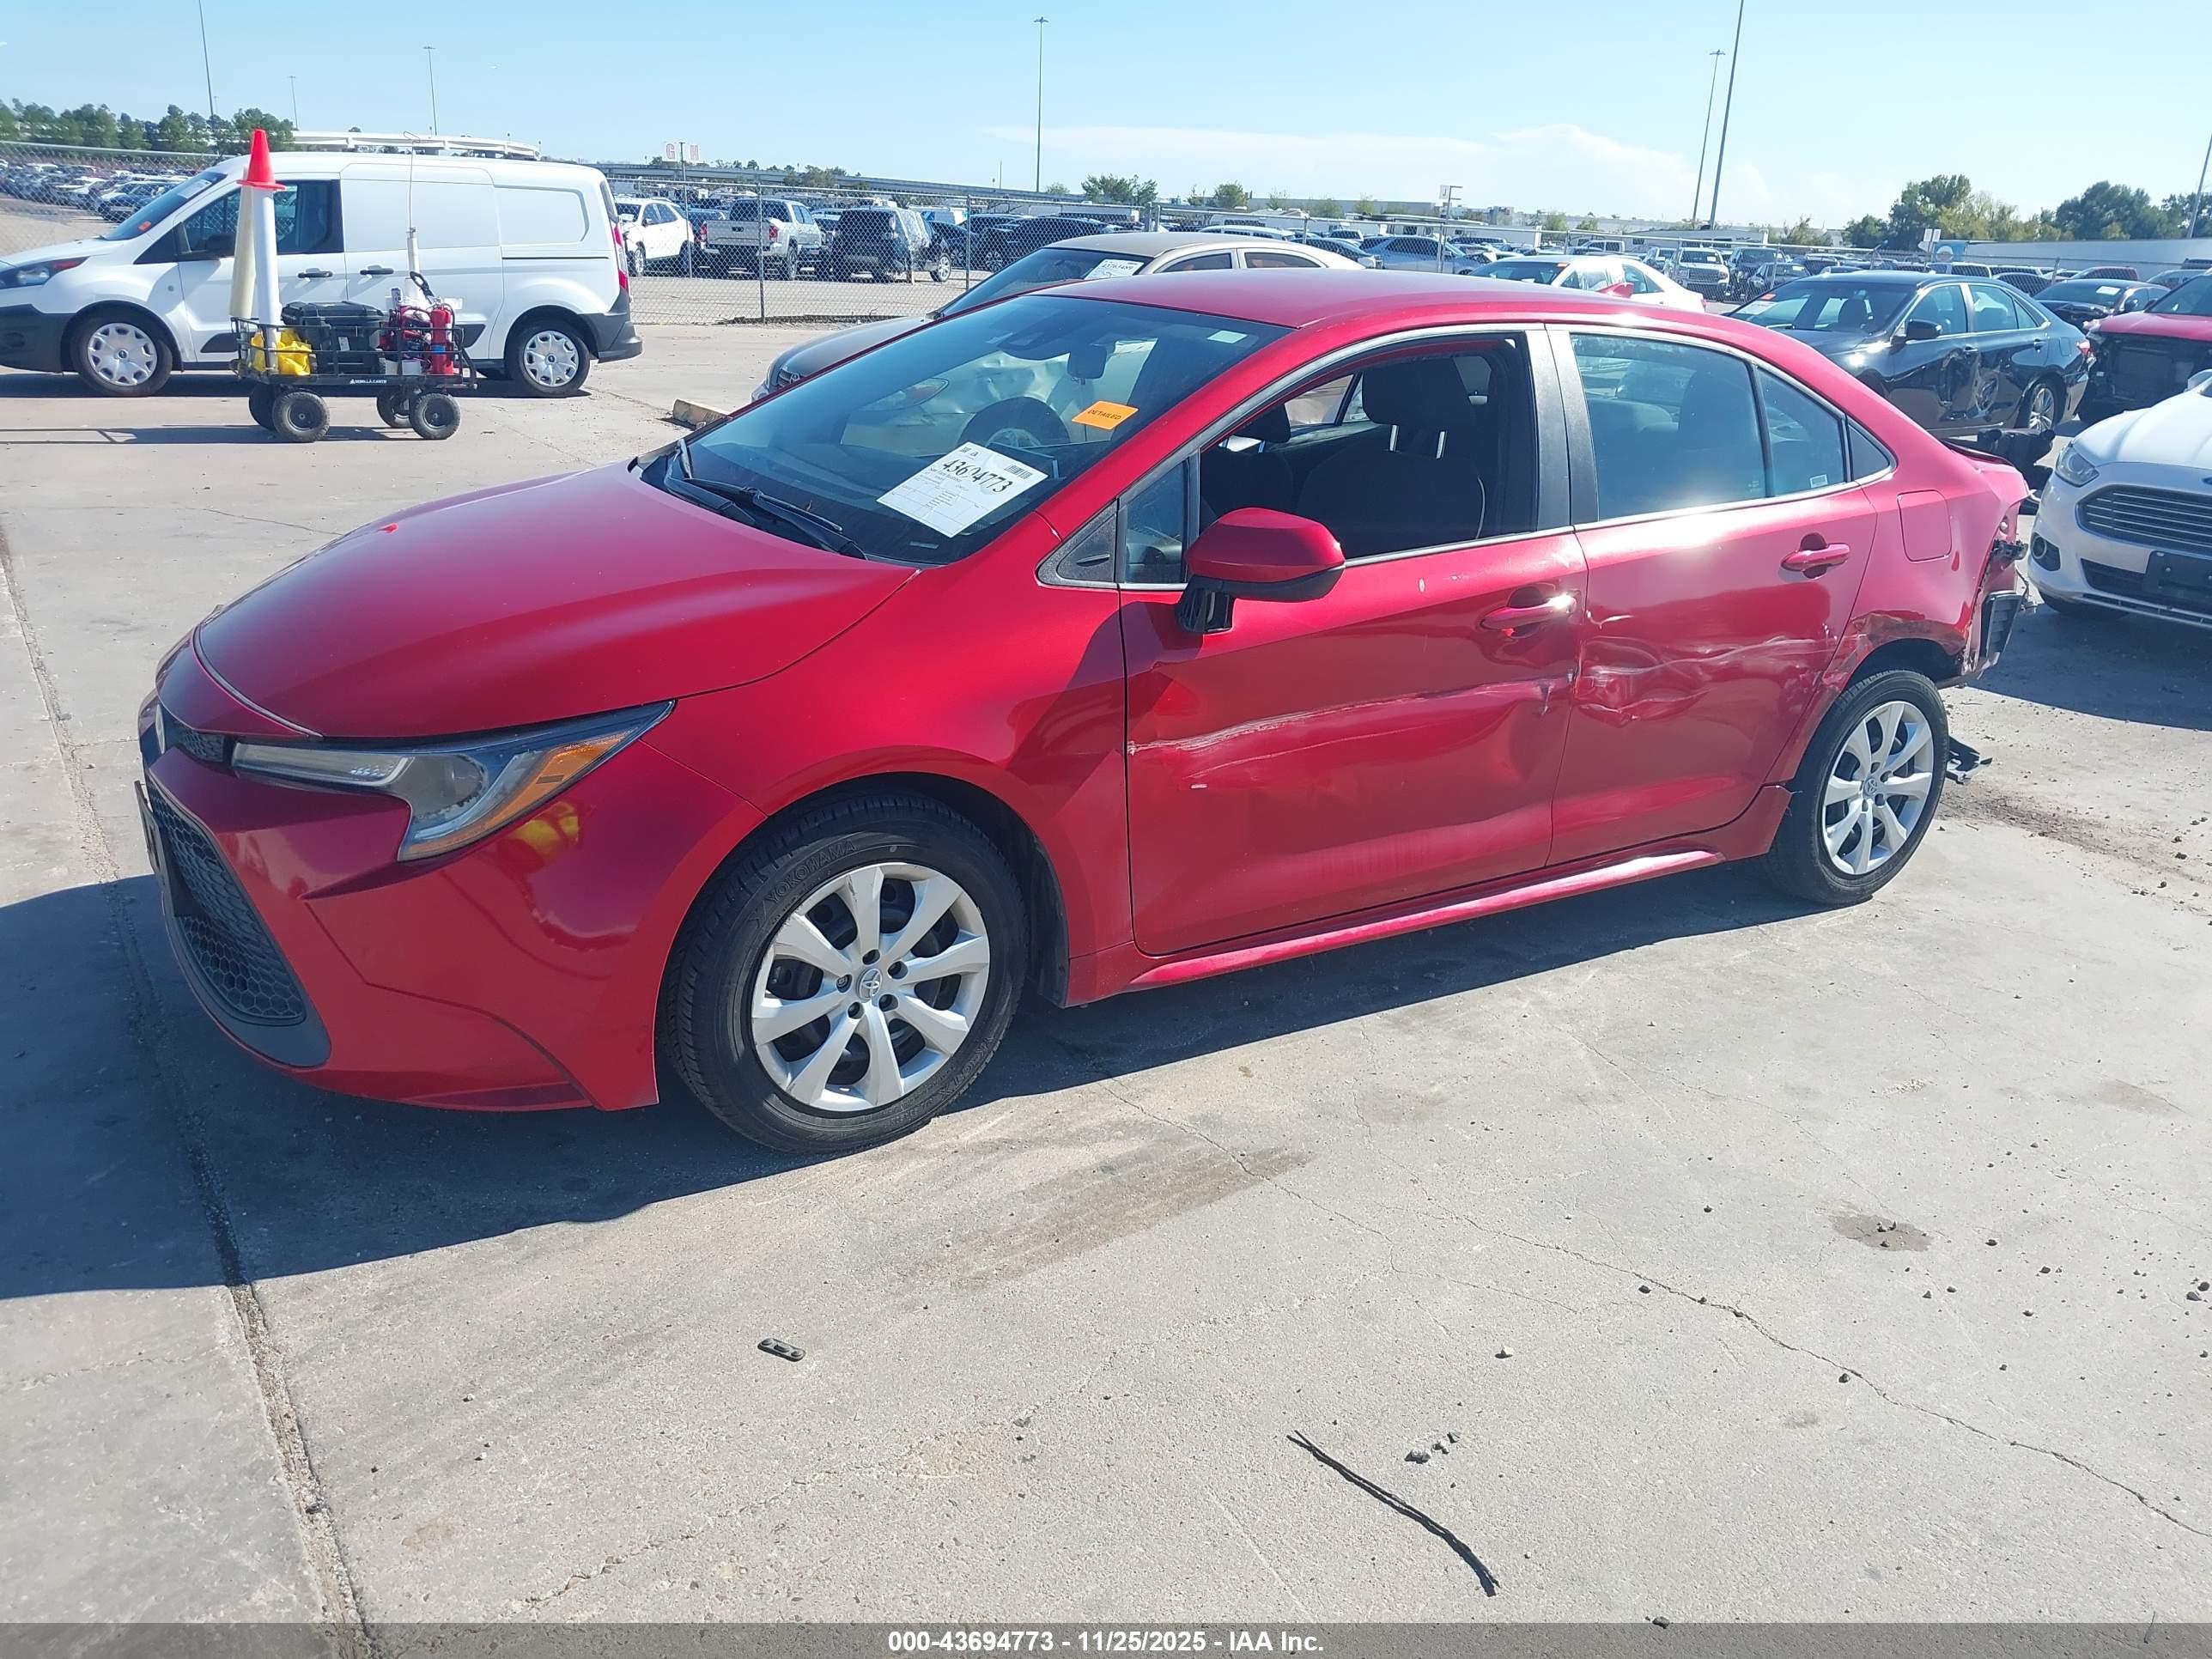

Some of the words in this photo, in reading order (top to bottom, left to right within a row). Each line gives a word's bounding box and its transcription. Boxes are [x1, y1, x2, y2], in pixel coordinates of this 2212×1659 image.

[666, 143, 675, 160] G
[690, 145, 700, 161] H
[1087, 410, 1121, 420] DETAILED
[941, 459, 1014, 495] 43694773
[766, 838, 857, 903] YOKOHAMA
